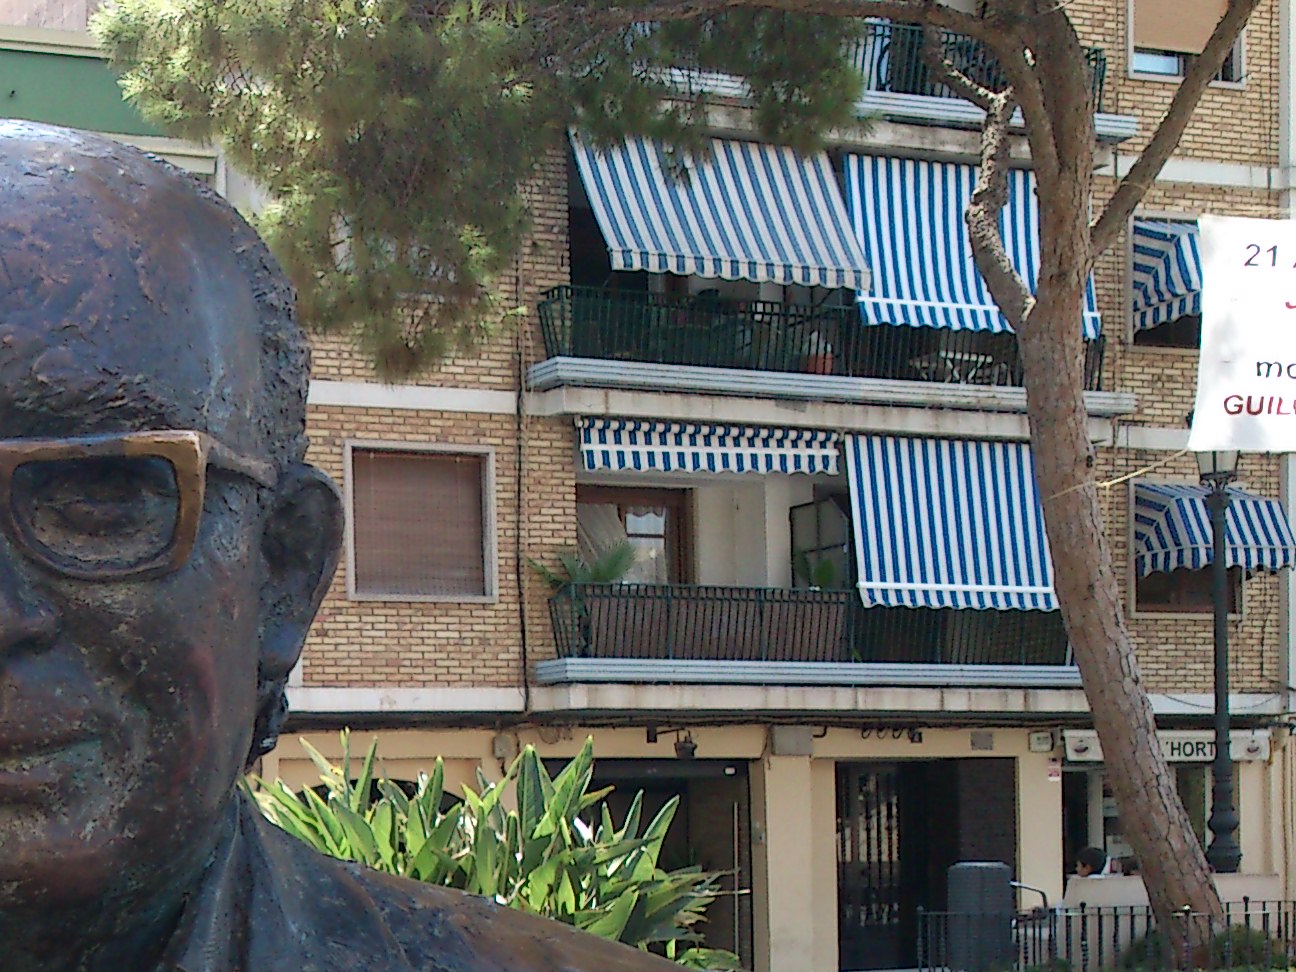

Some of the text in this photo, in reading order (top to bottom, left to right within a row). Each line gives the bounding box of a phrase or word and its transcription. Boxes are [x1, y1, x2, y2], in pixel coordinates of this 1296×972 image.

[1244, 244, 1278, 267] 21
[1223, 394, 1296, 416] GUIL
[1162, 741, 1217, 757] 'HORT
